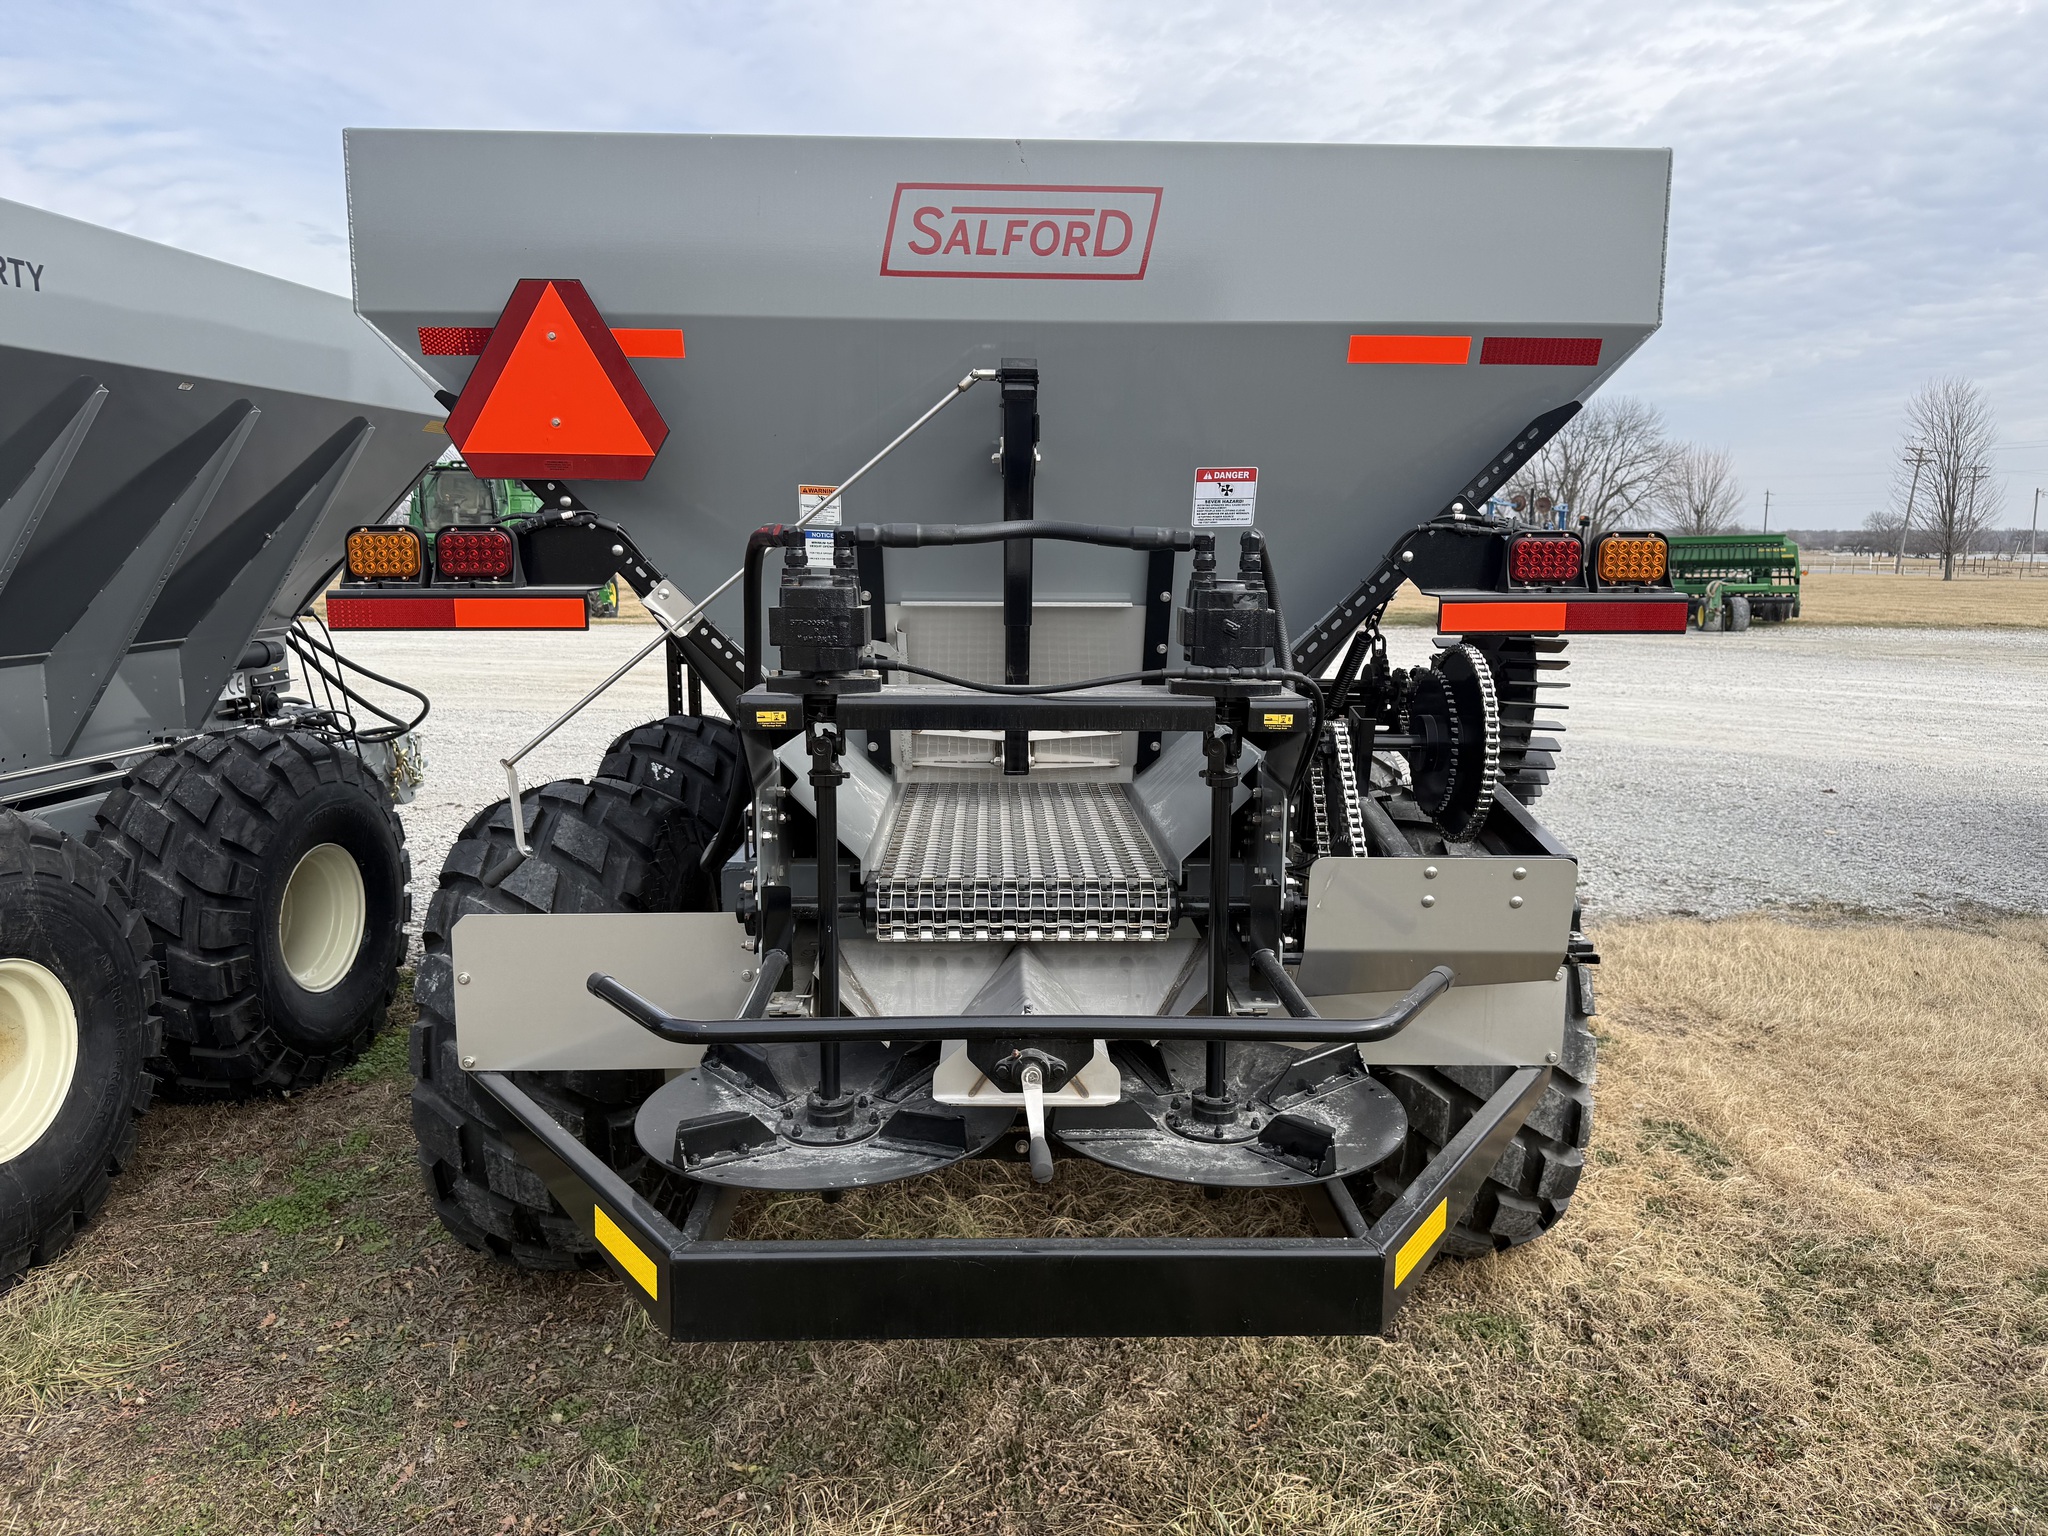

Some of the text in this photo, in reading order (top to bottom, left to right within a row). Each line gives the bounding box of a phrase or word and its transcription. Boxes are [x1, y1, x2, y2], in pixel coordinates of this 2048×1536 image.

[907, 206, 1133, 257] SALFORD
[1214, 471, 1250, 479] DANGER
[808, 487, 836, 495] WARNIN
